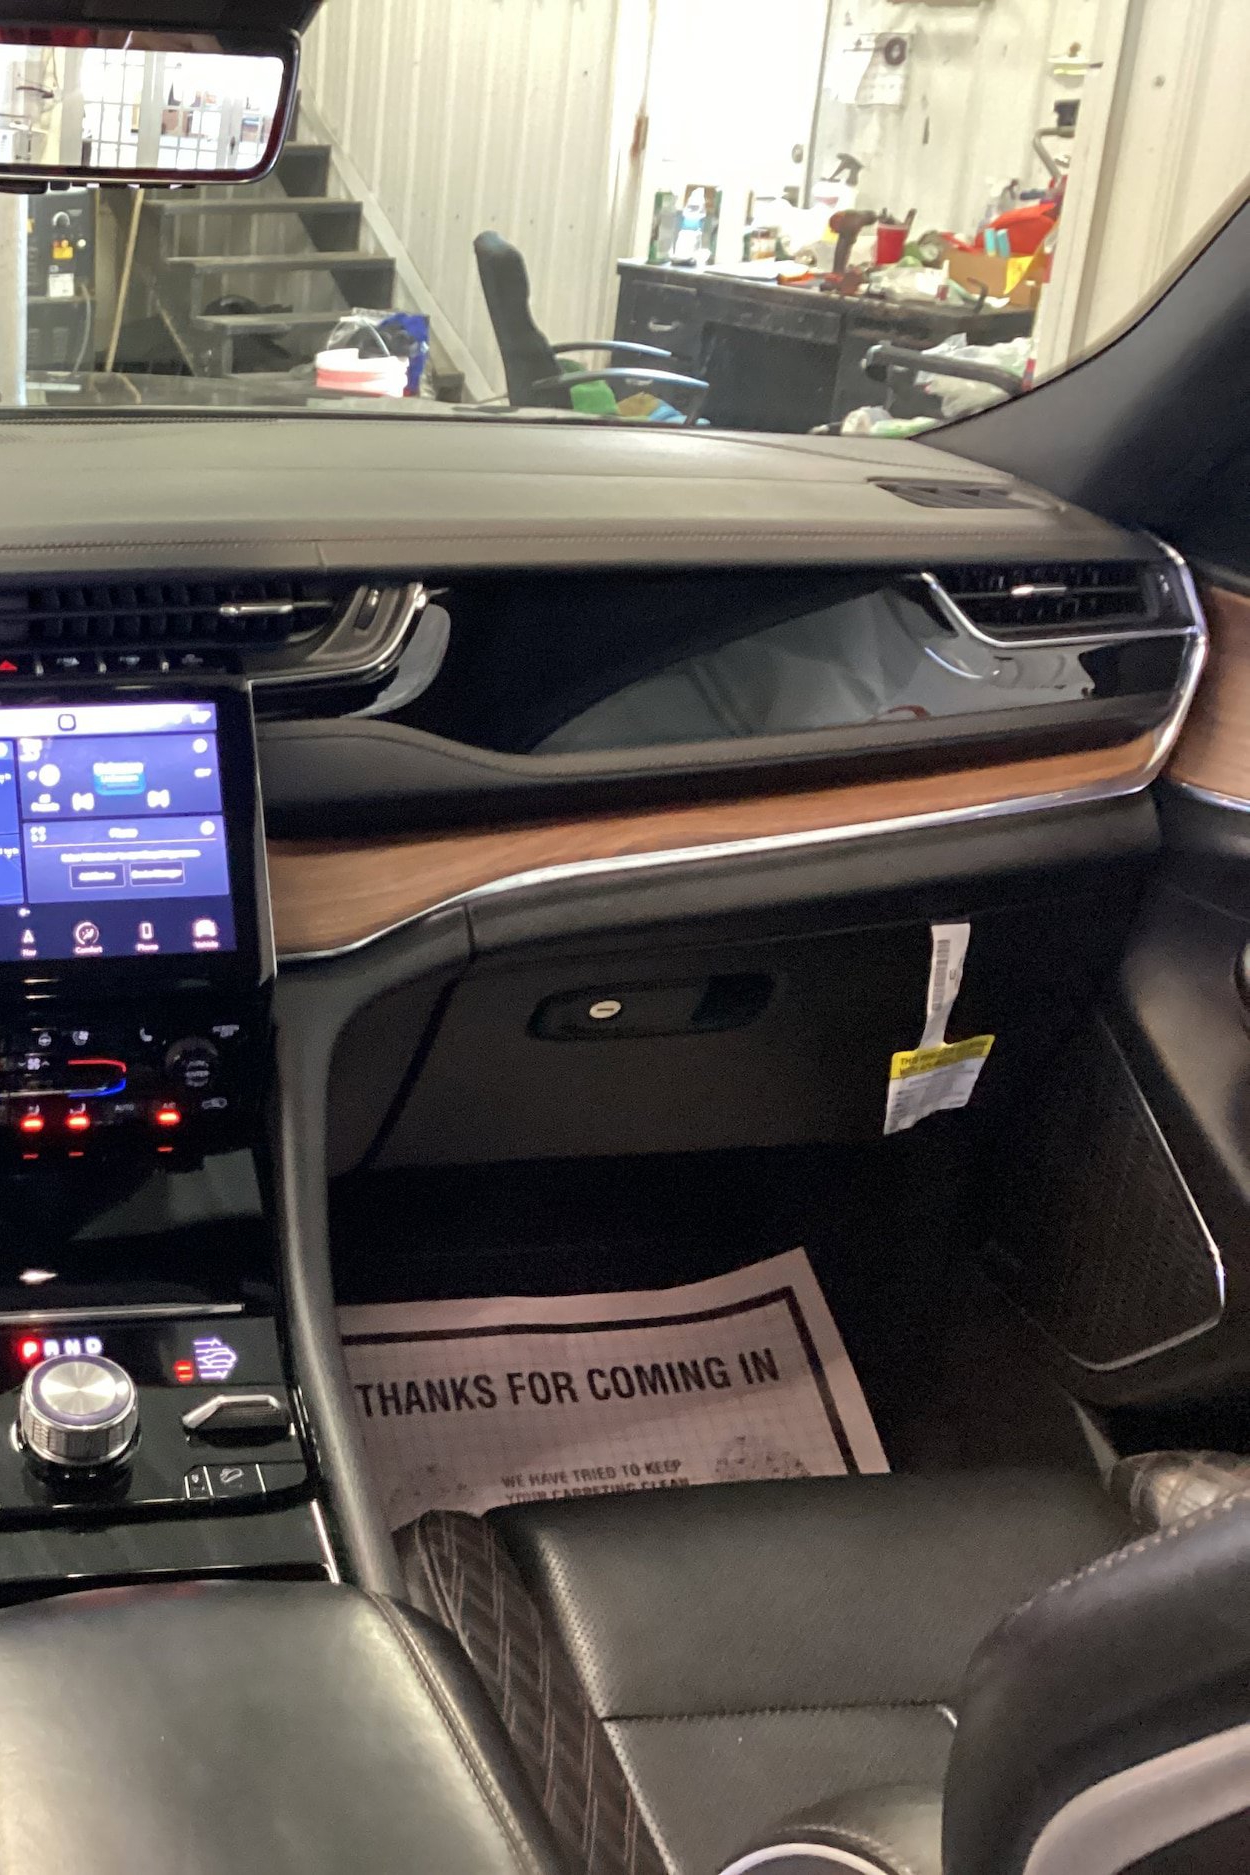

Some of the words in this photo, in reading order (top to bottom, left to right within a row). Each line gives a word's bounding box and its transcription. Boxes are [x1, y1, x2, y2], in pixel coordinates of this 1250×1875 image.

[23, 1341, 38, 1358] P
[85, 1337, 102, 1354] D
[355, 1374, 497, 1417] THANKS
[507, 1371, 579, 1406] FOR
[587, 1356, 731, 1401] COMING
[739, 1348, 780, 1384] IN
[501, 1474, 525, 1488] WE
[529, 1471, 568, 1486] HAVE
[572, 1466, 617, 1482] TRIED
[622, 1463, 641, 1477] TO
[644, 1459, 682, 1474] KEEP
